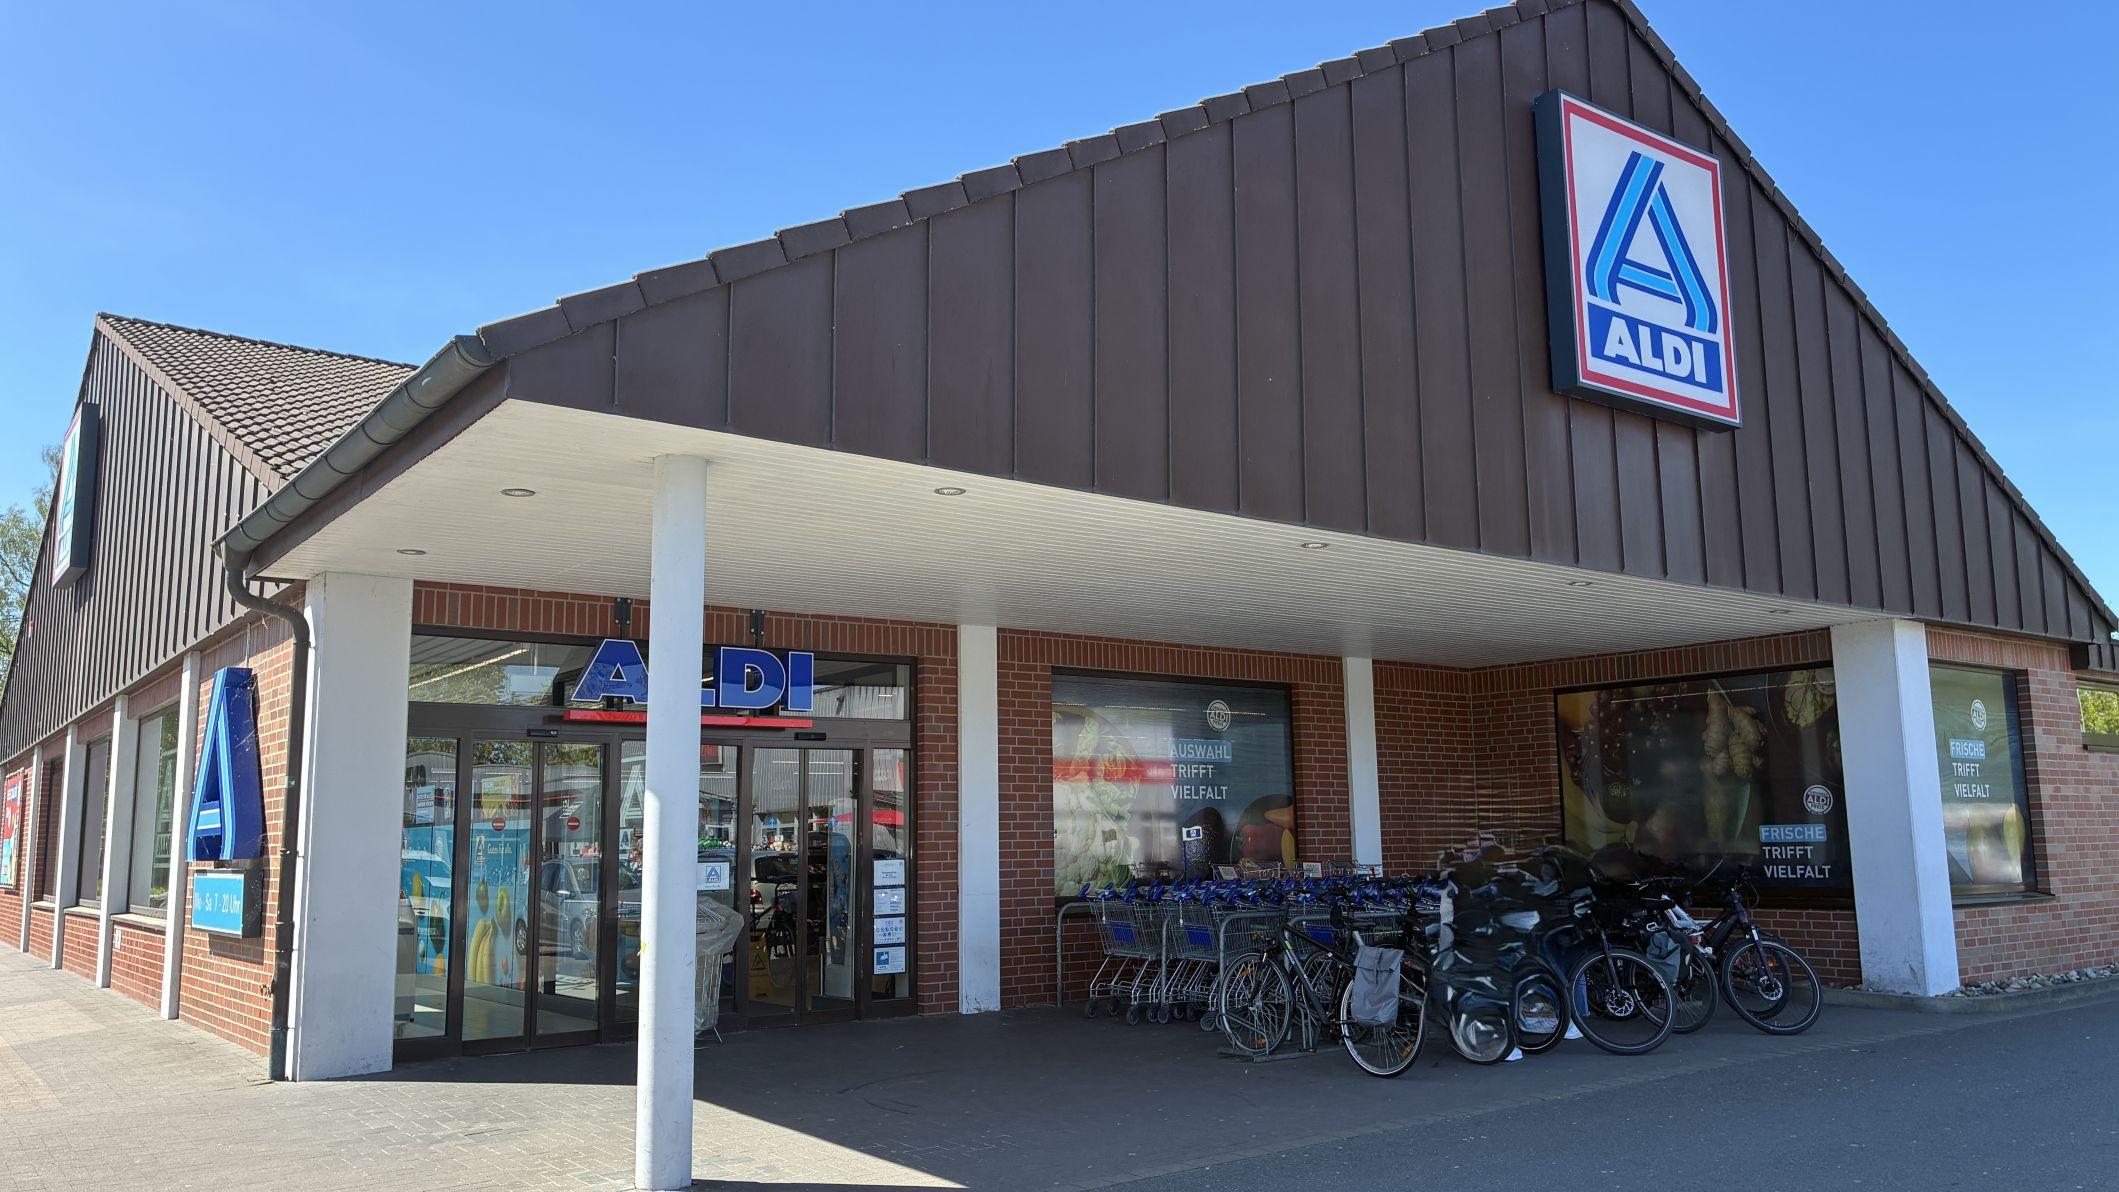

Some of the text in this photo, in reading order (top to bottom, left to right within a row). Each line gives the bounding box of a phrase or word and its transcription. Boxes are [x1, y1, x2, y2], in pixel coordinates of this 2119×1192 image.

[1603, 316, 1707, 384] ALDI
[571, 639, 814, 711] ADI
[1170, 743, 1231, 759] AUSWAHL
[1950, 741, 1985, 756] FRISCHE
[1170, 764, 1214, 778] TRIFFT
[1952, 762, 1979, 777] TRIFFT
[1171, 785, 1228, 800] VIELFALT
[1954, 783, 1990, 798] VIELFALT
[1807, 795, 1830, 806] ALDI
[1762, 827, 1825, 840] FRISCHE
[1762, 846, 1814, 859] TRIFFT
[1763, 865, 1831, 878] VIELFALT
[230, 894, 241, 915] Uhr
